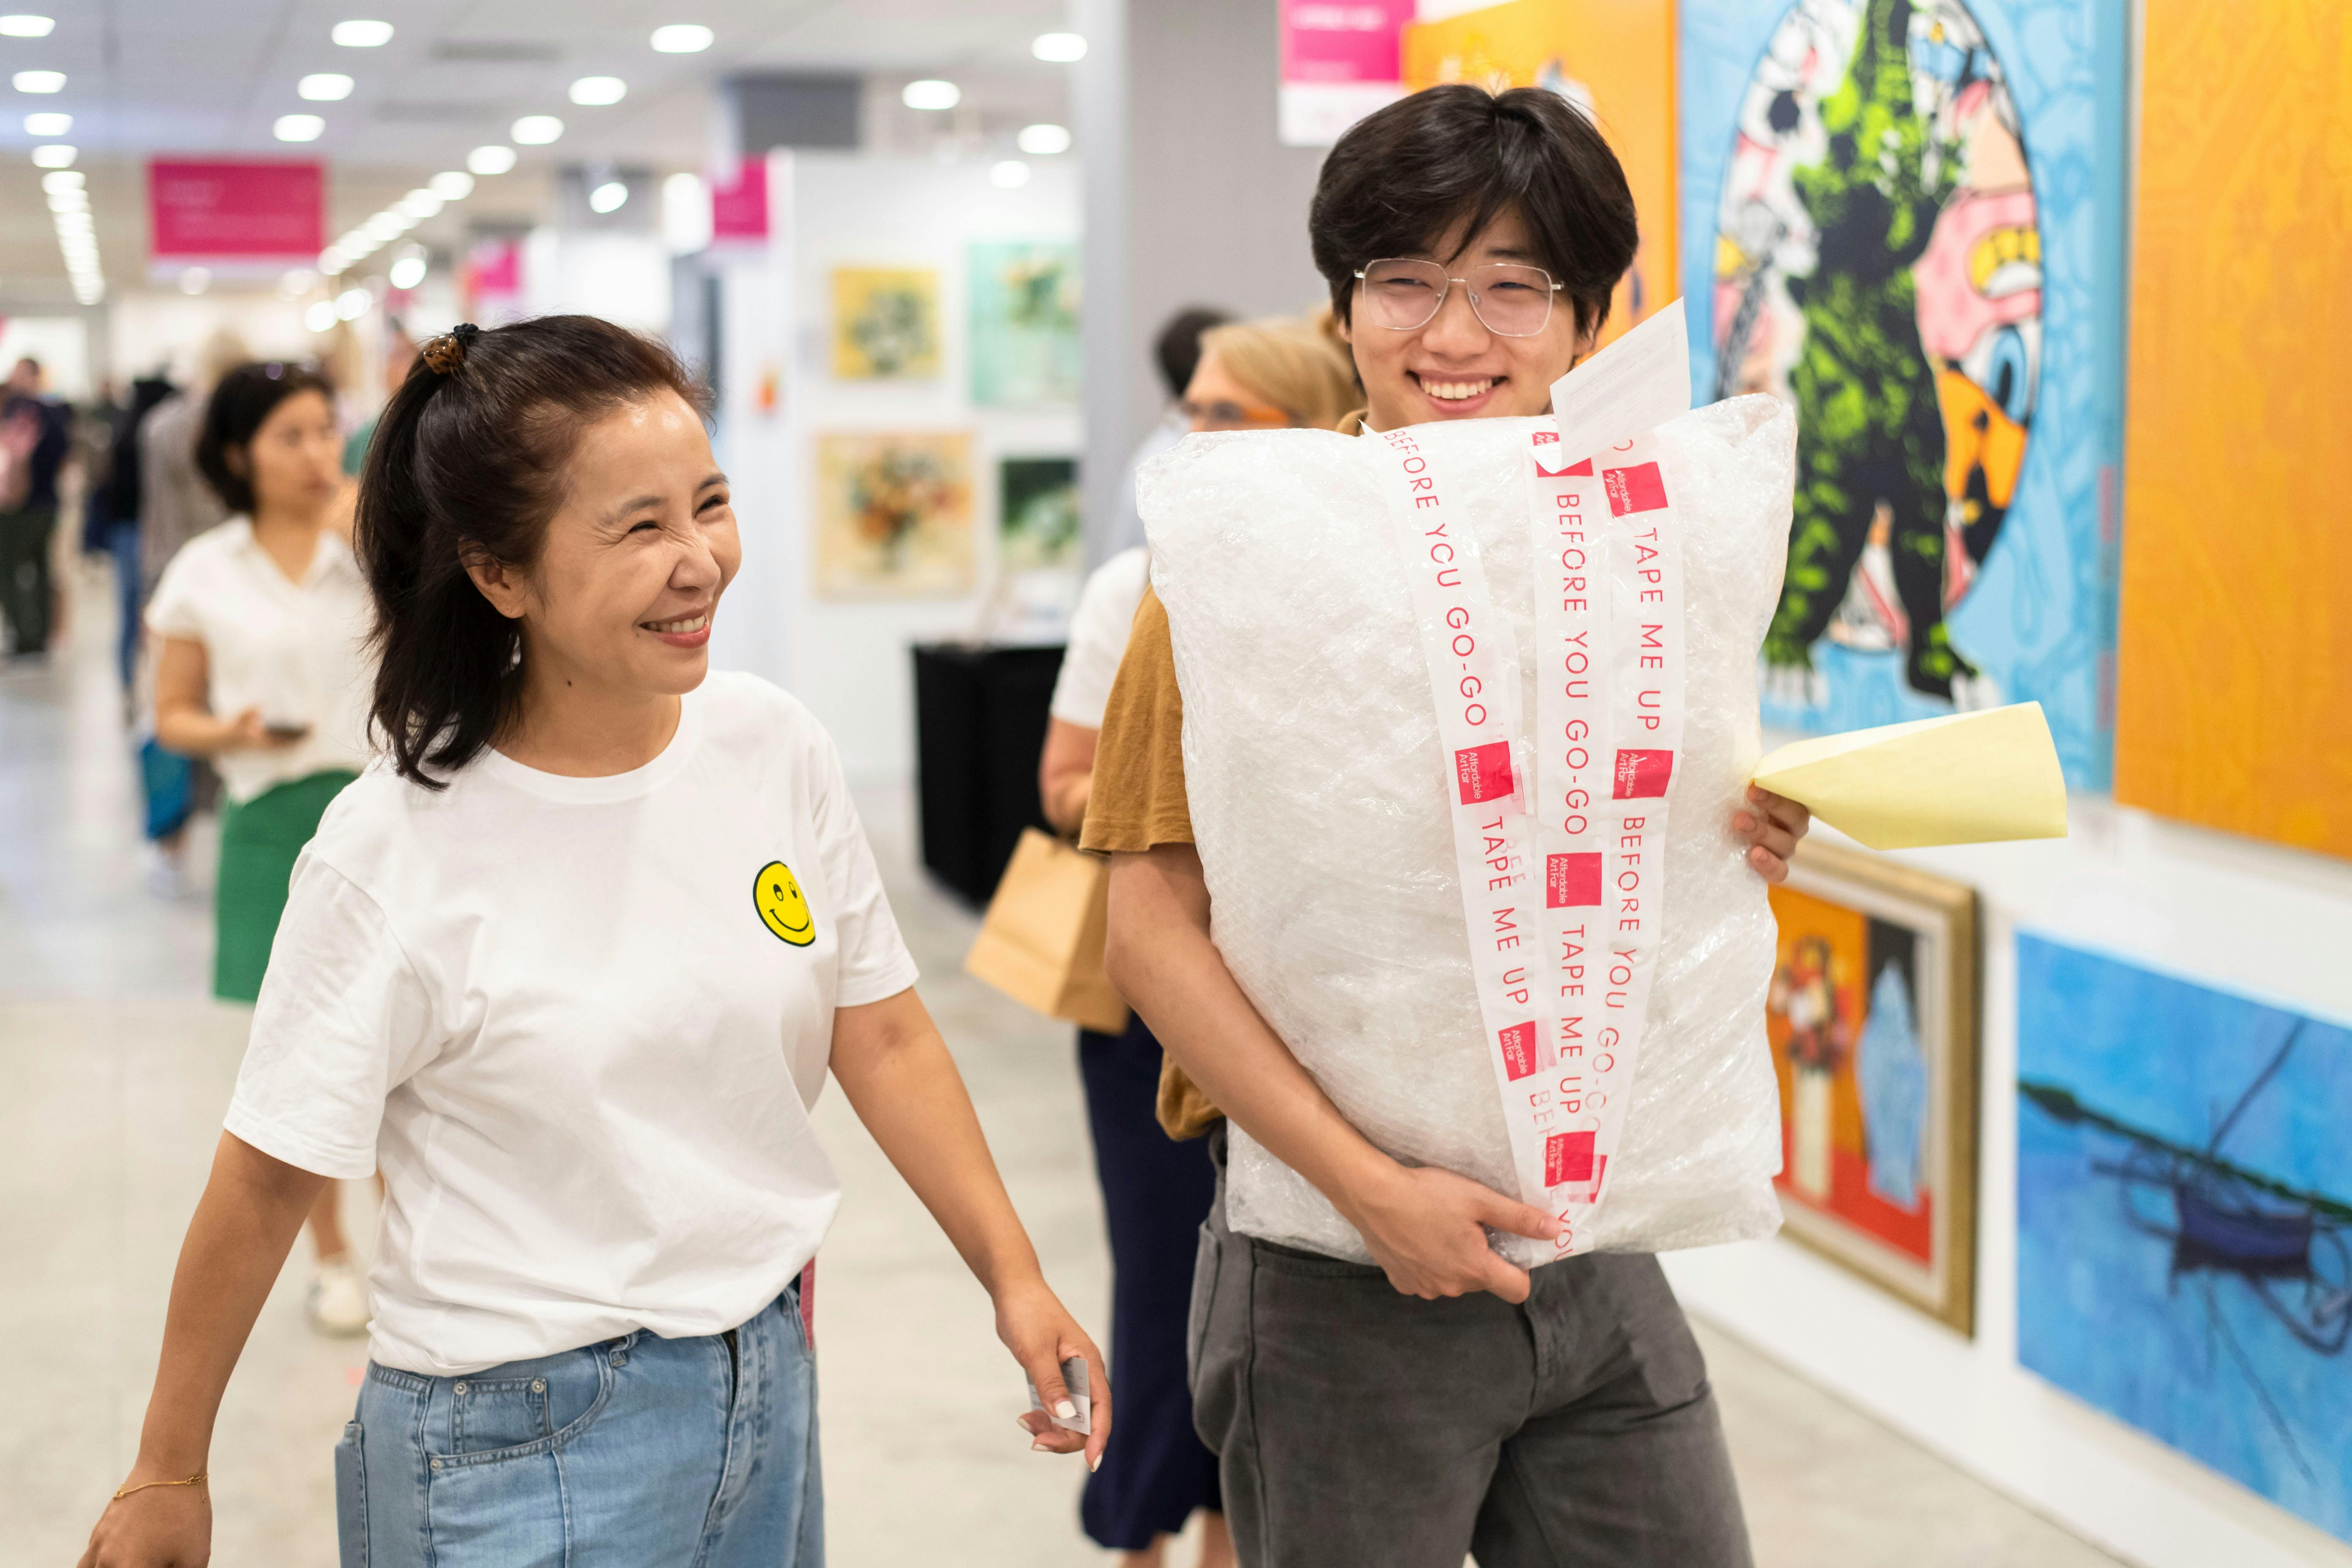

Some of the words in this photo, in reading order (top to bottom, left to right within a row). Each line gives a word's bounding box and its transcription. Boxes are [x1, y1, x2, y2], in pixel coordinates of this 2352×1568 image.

[1557, 494, 1587, 611] BEFORE
[1633, 528, 1663, 603] TAPE
[1384, 431, 1439, 509] BEFORE
[1425, 523, 1461, 587] YOU
[1446, 607, 1486, 726] GO-GO
[1565, 631, 1588, 698] YOU
[1641, 625, 1663, 668] ME
[1637, 691, 1661, 730] UP
[1459, 754, 1468, 767] Art
[1461, 768, 1470, 784] Fair
[1469, 752, 1483, 799] Affordable
[1564, 719, 1589, 835] GO-GO
[1618, 767, 1628, 782] Fair
[1619, 753, 1629, 765] Art
[1625, 753, 1638, 796] Affordable
[1482, 815, 1511, 890] TAPE
[1550, 858, 1558, 871] Art
[1618, 817, 1645, 931] BEFORE
[1550, 873, 1558, 888] Fair
[1559, 858, 1568, 904] Affordable
[1493, 908, 1519, 951] ME
[1561, 924, 1584, 996] TAPE
[1605, 949, 1637, 1008] YOU
[1503, 967, 1528, 1004] UP
[1503, 1033, 1512, 1046] Art
[1505, 1045, 1515, 1061] Fair
[1511, 1030, 1527, 1074] Affordable
[1560, 1017, 1583, 1058] ME
[1560, 1077, 1581, 1113] UP
